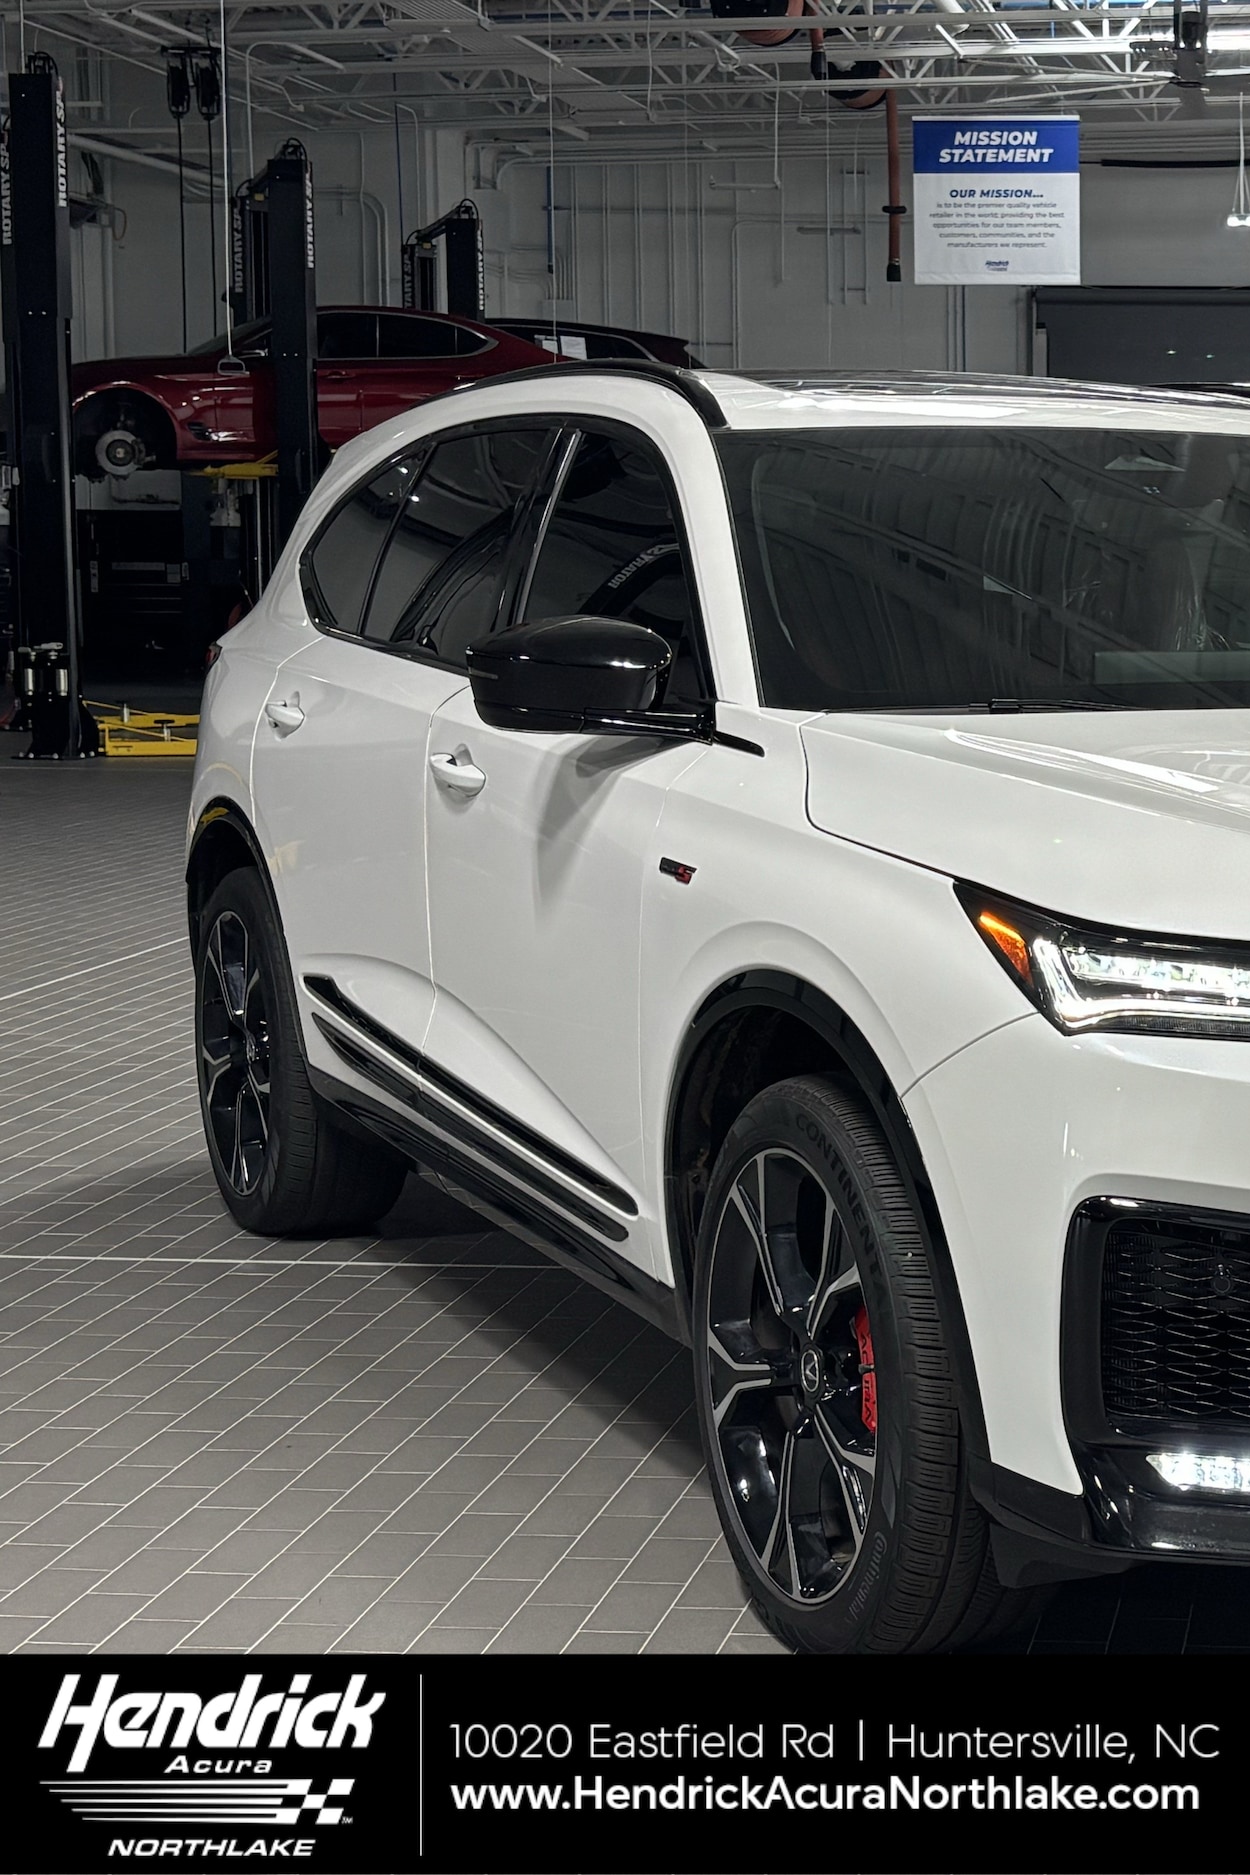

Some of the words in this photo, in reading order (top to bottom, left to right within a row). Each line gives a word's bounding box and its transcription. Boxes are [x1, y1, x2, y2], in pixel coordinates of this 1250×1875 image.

[56, 124, 67, 208] ROTARY
[939, 148, 1054, 163] STATEMENT
[954, 131, 1037, 146] MISSION
[0, 172, 13, 245] ROTARY
[949, 189, 976, 198] OUR
[979, 189, 1044, 198] MISSION...
[233, 230, 243, 293] ROTARY
[305, 199, 315, 269] ROTARY
[861, 1332, 873, 1406] ACRA
